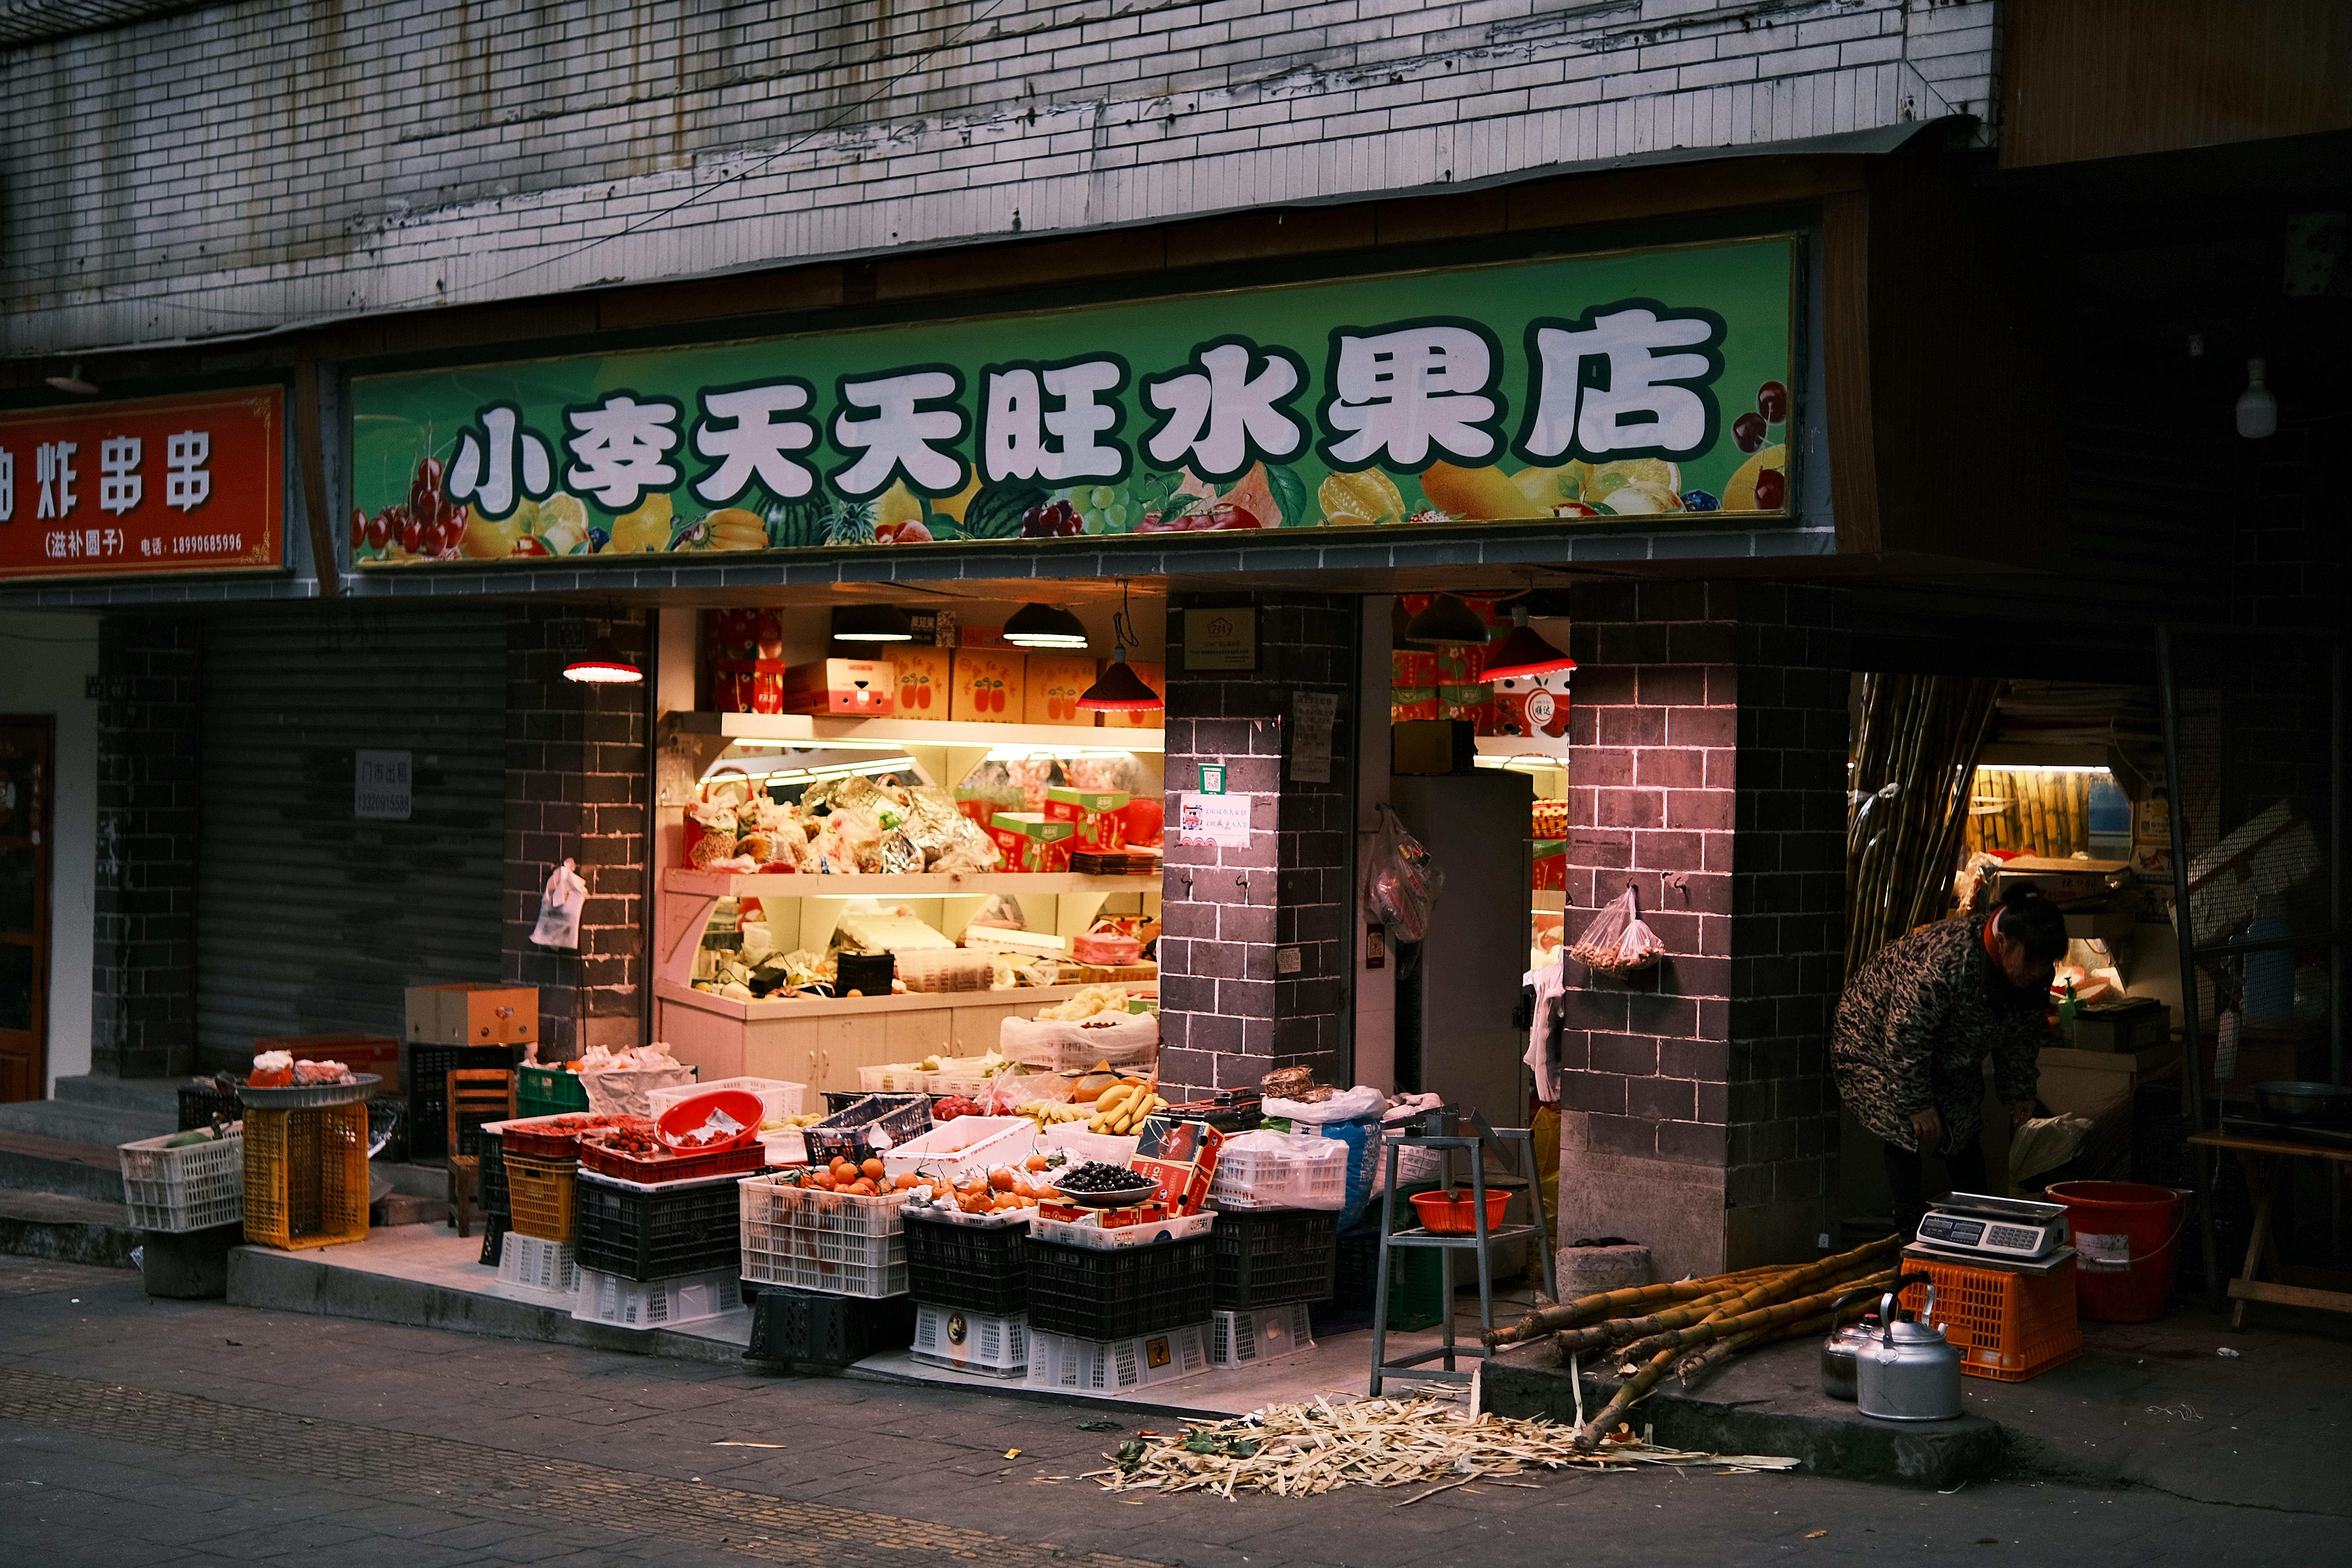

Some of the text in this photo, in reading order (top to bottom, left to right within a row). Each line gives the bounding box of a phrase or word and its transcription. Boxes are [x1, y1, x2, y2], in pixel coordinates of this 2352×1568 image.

[448, 307, 1713, 516] 小李天天旺水果店
[362, 760, 407, 784] 门市出租
